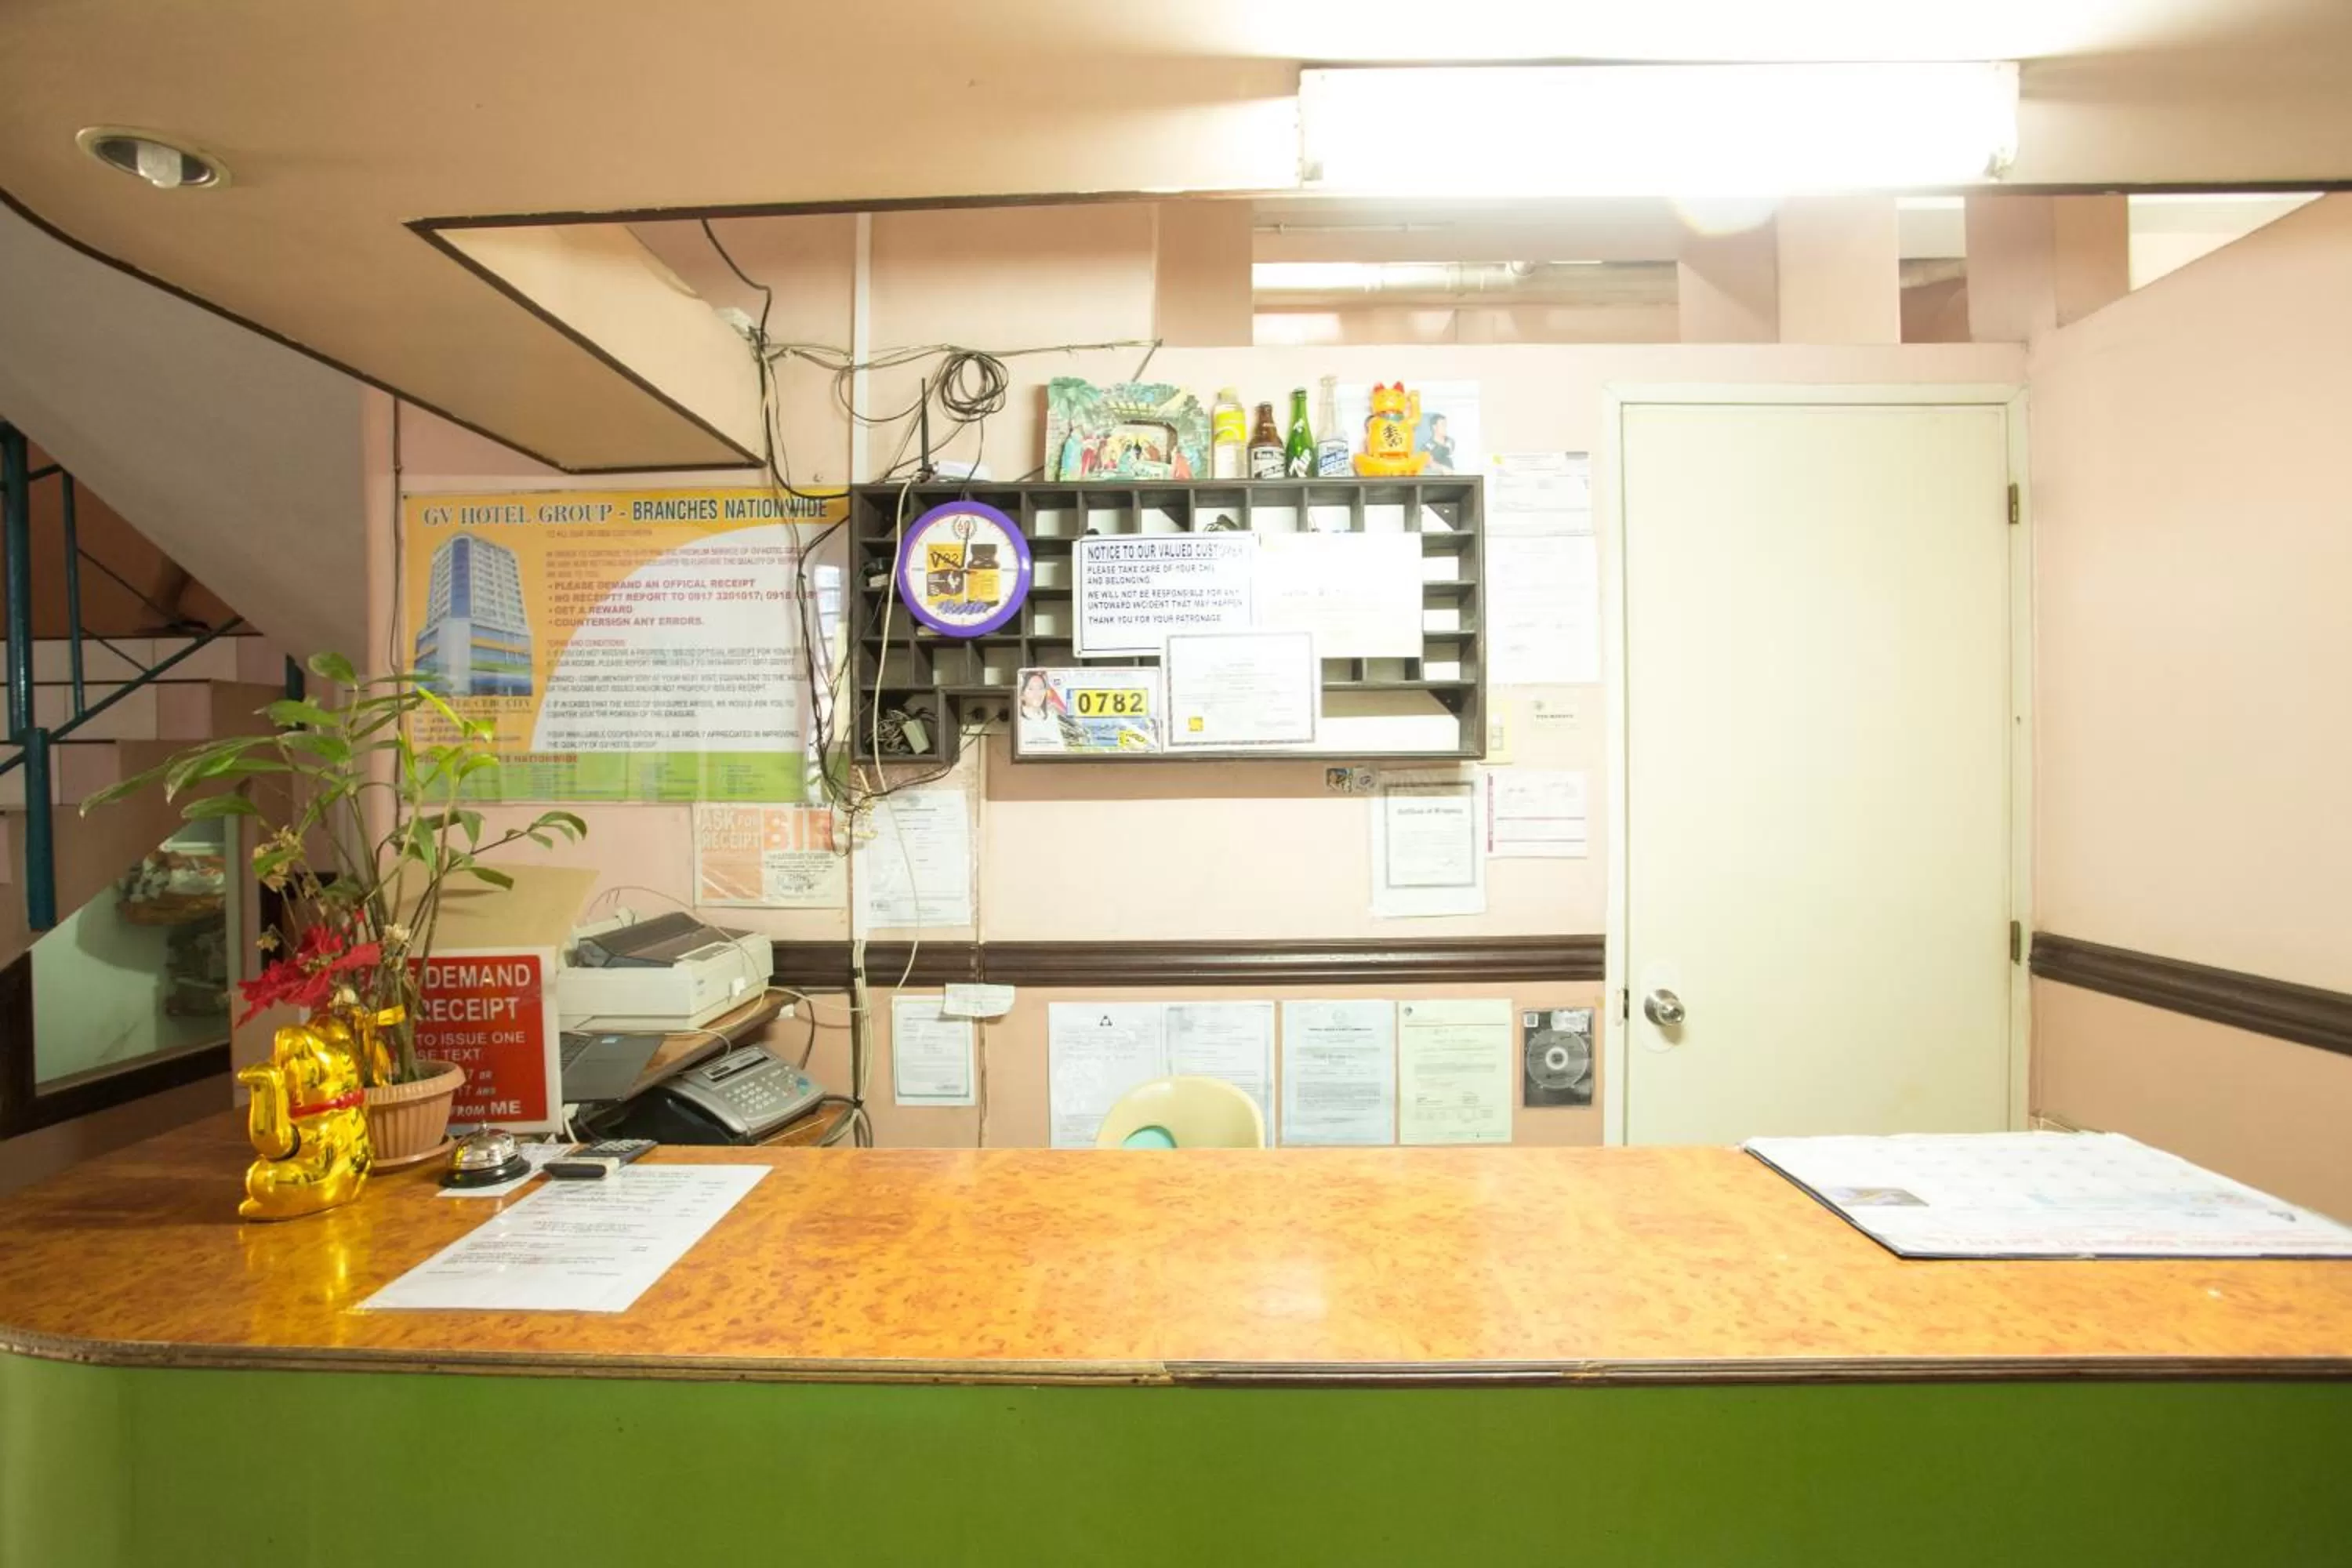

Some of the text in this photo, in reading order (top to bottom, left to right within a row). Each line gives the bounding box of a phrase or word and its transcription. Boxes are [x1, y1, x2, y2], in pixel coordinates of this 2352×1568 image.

[424, 506, 452, 526] GV
[460, 506, 532, 524] HOTEL
[539, 504, 613, 523] GROUP
[633, 499, 717, 521] BRANCHES
[724, 498, 827, 519] NATIONWIDE
[1087, 545, 1120, 560] NOTICE
[1123, 545, 1134, 559] TO
[1137, 544, 1156, 558] OUR
[1159, 543, 1192, 557] VALUED
[1087, 564, 1116, 574] PLEASE
[1117, 564, 1138, 573] TAKE
[1140, 564, 1160, 574] CARE
[1163, 564, 1173, 573] OF
[554, 581, 593, 590] PLEASE
[597, 580, 642, 590] DEMAND
[645, 580, 659, 589] AN
[710, 579, 756, 588] RECEIPT
[626, 592, 667, 601] REPORT
[672, 592, 684, 601] TO
[1087, 590, 1100, 599] WE
[1139, 590, 1149, 598] BE
[1152, 589, 1204, 598] RESPONSIBLE
[554, 606, 576, 615] GET
[588, 605, 633, 614] REWARD
[1087, 601, 1131, 610] UNTOWARD
[1133, 600, 1169, 609] INCIDENT
[1171, 600, 1191, 608] THAT
[554, 617, 631, 626] COUNTERSIGN
[633, 617, 655, 626] ANY
[1087, 615, 1115, 624] THANK
[1117, 615, 1132, 624] YOU
[1134, 615, 1149, 623] FOR
[1152, 614, 1174, 623] YOUR
[1078, 693, 1144, 713] 0782
[703, 809, 735, 830] ASK
[702, 830, 760, 848] RECEIPT
[426, 964, 532, 989] DEMAND
[417, 1031, 525, 1046] TO ISSUE ONE
[444, 1048, 481, 1060] TEXT
[490, 1100, 522, 1116] ME
